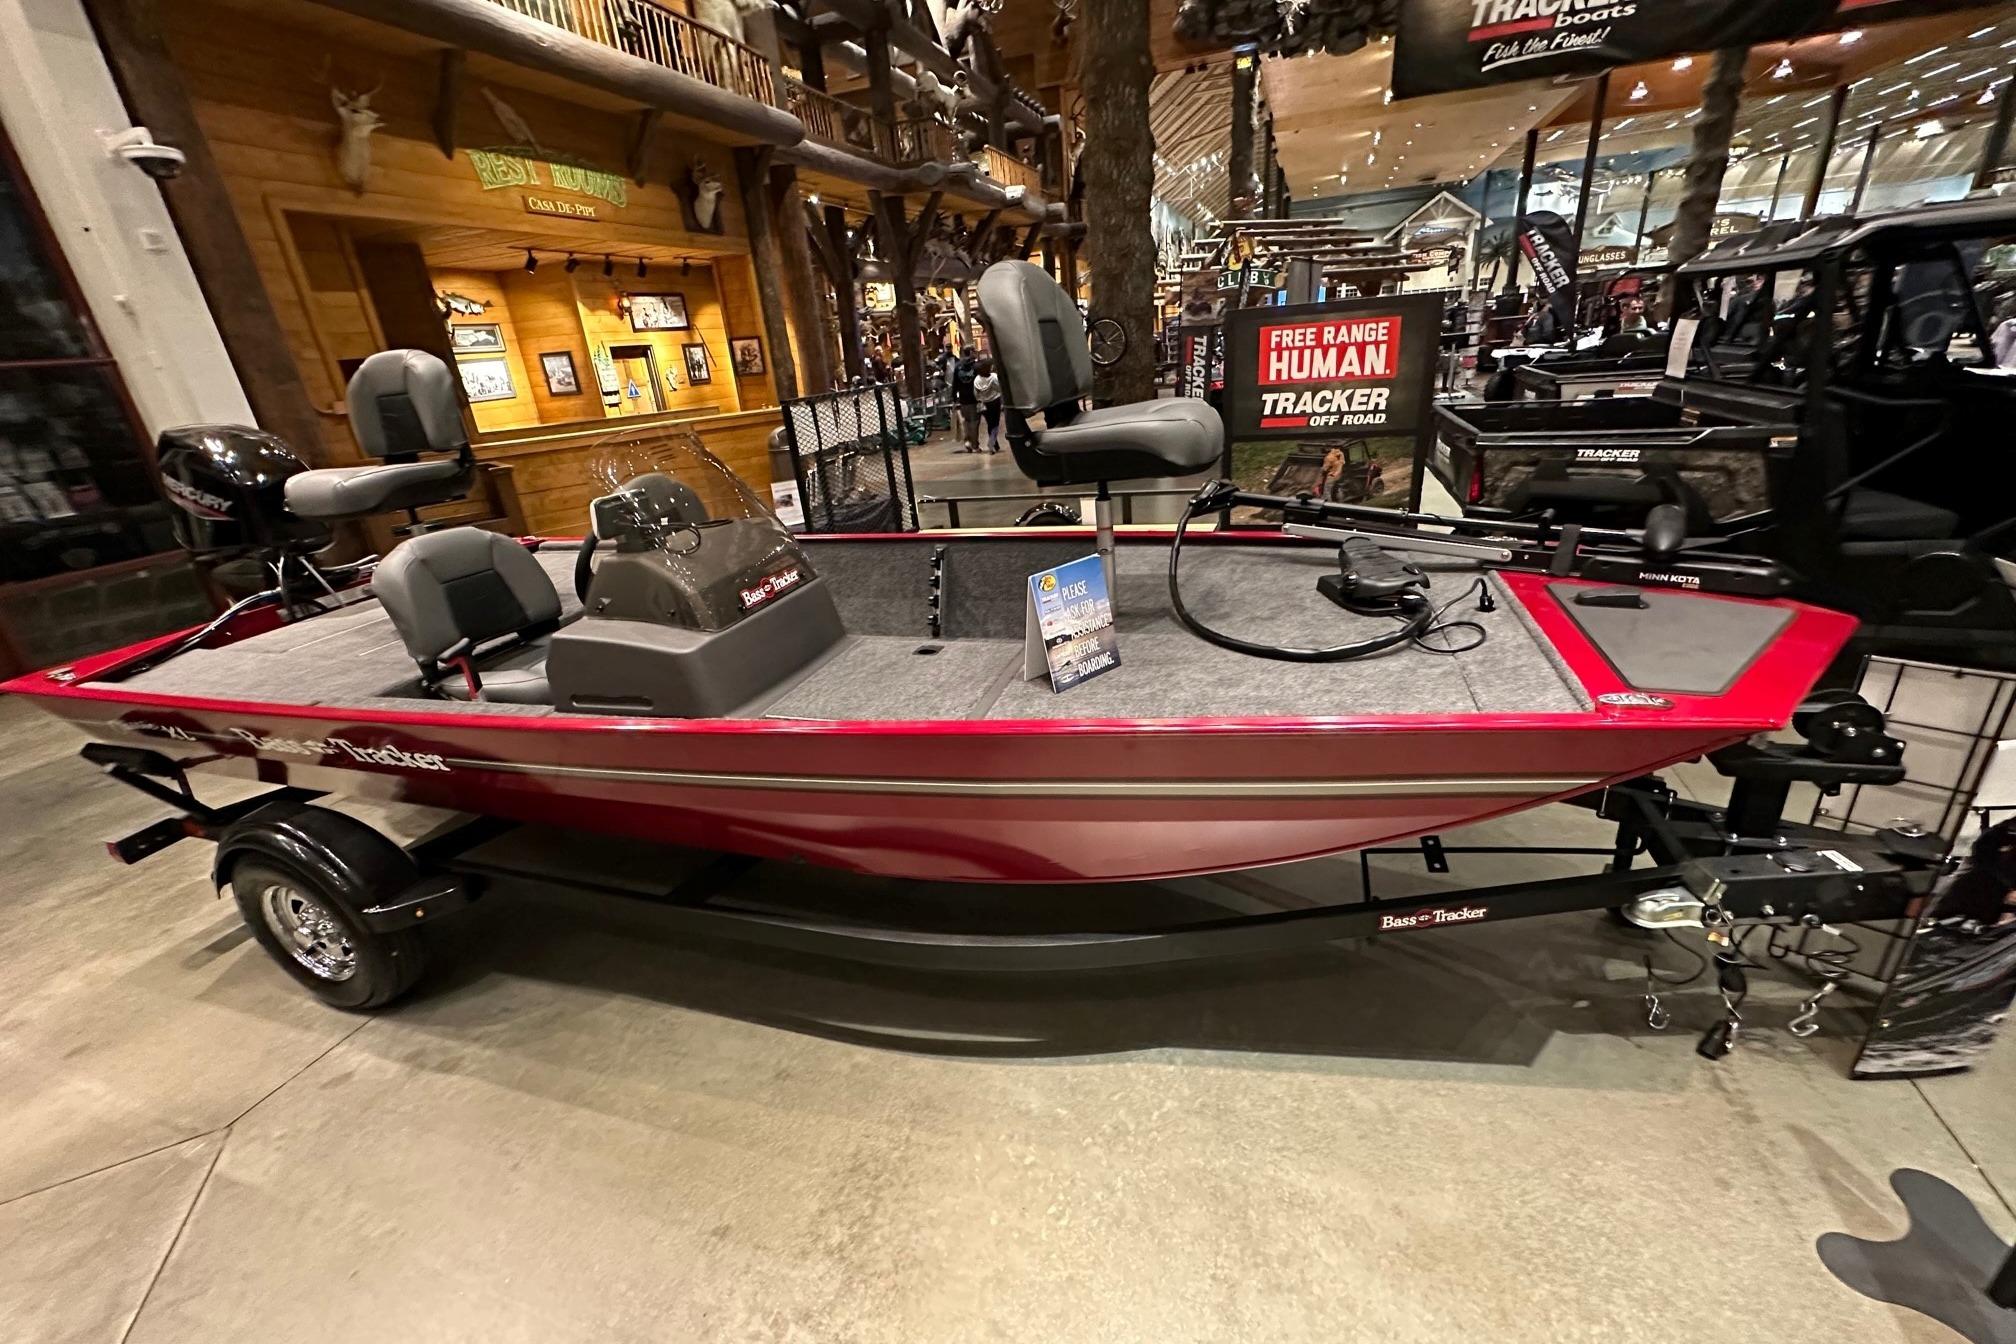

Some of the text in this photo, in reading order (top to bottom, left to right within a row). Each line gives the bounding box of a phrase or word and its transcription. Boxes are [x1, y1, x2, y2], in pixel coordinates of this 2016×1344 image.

[1554, 4, 1636, 27] boats
[1482, 26, 1611, 62] Fish the Finest!
[466, 150, 628, 208] REST ROOMS
[528, 197, 555, 211] CASA
[1527, 228, 1570, 288] TRACKER
[1578, 251, 1626, 264] UNGLASSES
[1217, 271, 1259, 288] CLB
[1531, 257, 1556, 294] OFF ROAD
[1270, 322, 1390, 349] FREE RANGE
[1192, 335, 1208, 400] TRACKE
[1269, 344, 1391, 381] HUMAN.
[1184, 365, 1193, 398] OFF RO
[1261, 387, 1390, 416] TRACKER
[1309, 415, 1339, 427] OFF
[1577, 448, 1641, 458] TRACKER
[741, 570, 799, 606] Bass Tracker
[1062, 580, 1088, 601] PLEASE
[1639, 572, 1700, 584] MINN KOTA
[1066, 605, 1081, 621] ASK
[1081, 599, 1095, 617] FOR
[1071, 613, 1110, 639] ASSISTANCE
[1074, 636, 1101, 657] BEFORE
[1077, 652, 1115, 677] BOARDING.
[326, 737, 451, 772] Tracker
[1382, 907, 1487, 929] Bass Tracker
